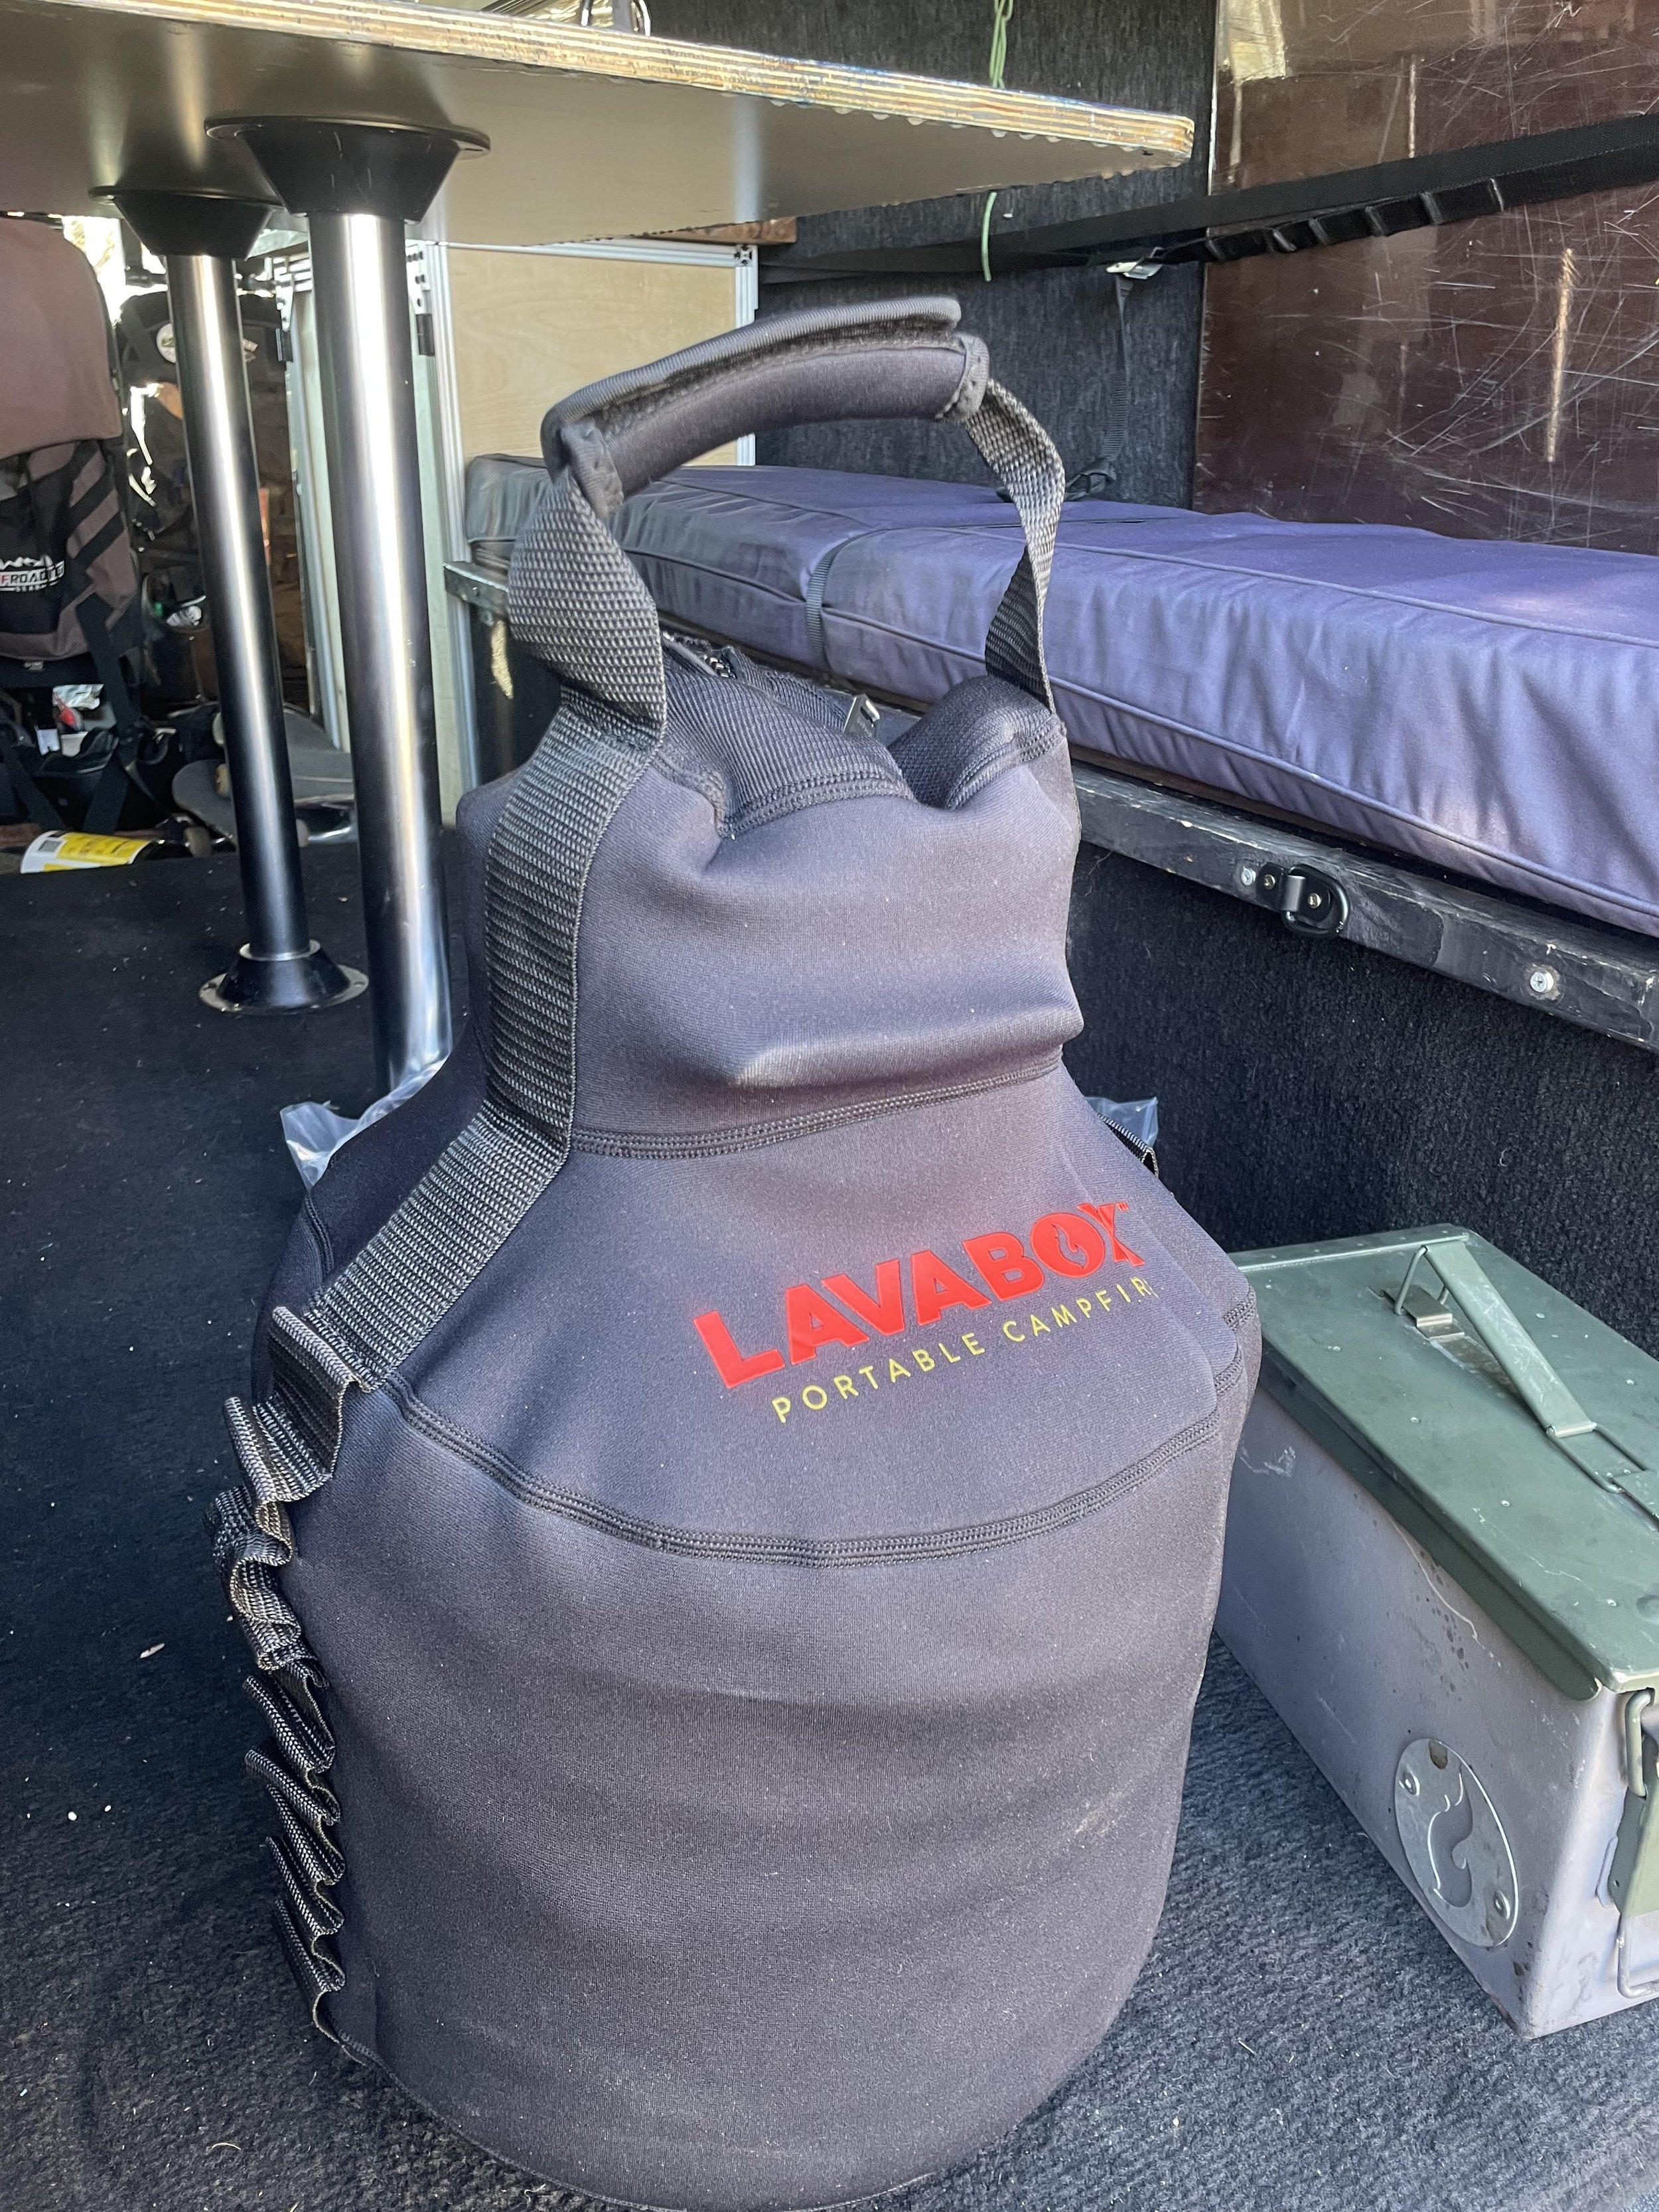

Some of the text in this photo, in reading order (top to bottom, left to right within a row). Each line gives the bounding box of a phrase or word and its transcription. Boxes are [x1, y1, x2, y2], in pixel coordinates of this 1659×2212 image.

[695, 1203, 1144, 1388] LAVABOX
[772, 1276, 1159, 1423] PORTABLE CAMPFIR
